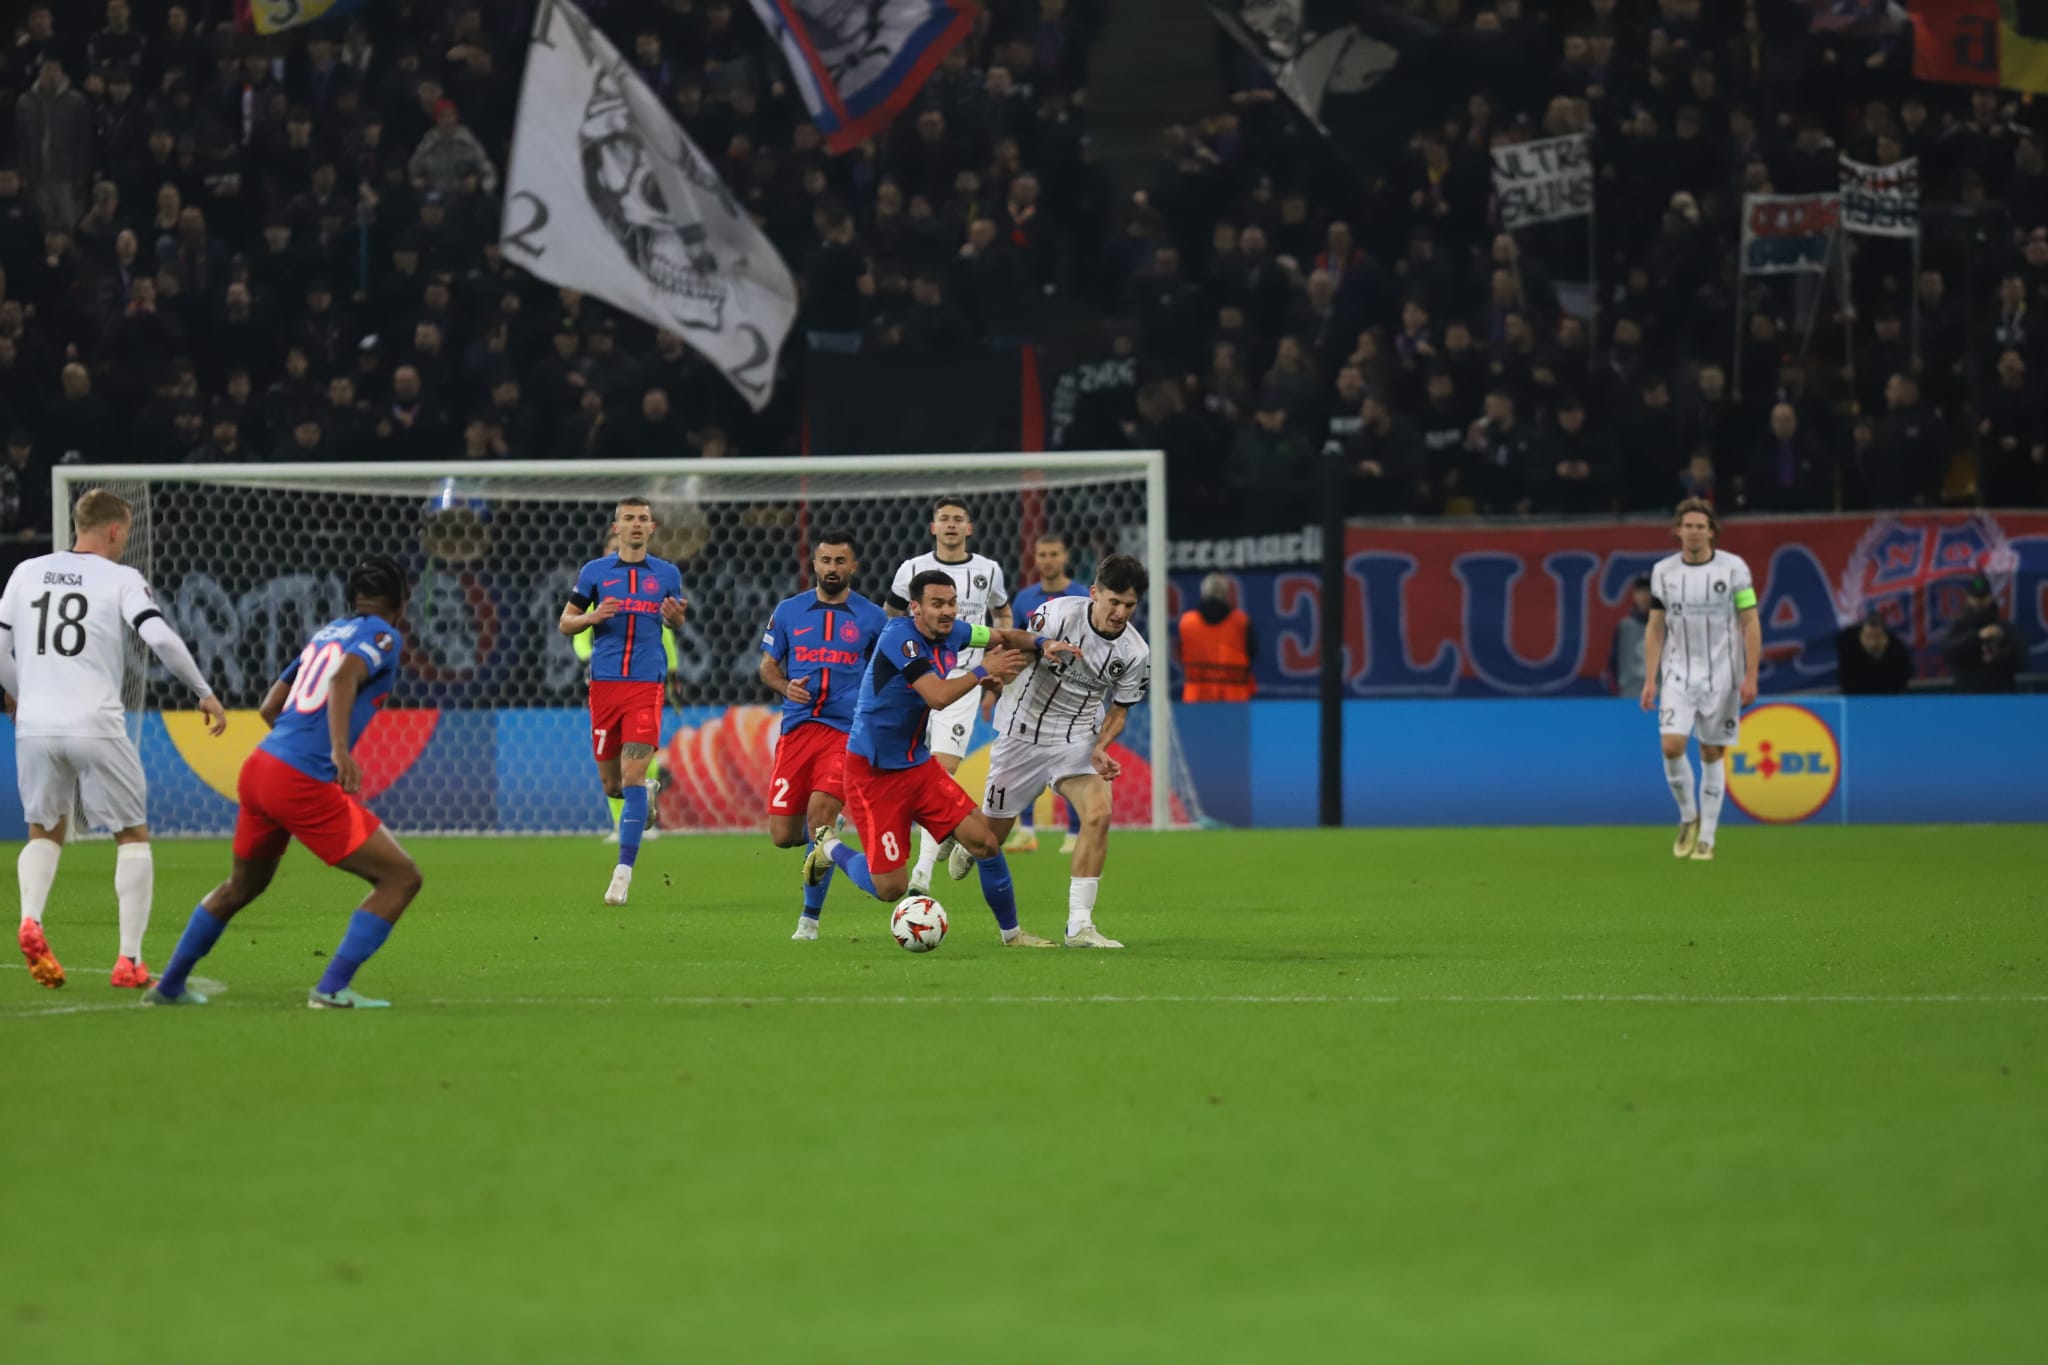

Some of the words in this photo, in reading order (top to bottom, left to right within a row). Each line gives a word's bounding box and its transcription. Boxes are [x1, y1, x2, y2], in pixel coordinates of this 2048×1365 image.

[43, 571, 83, 587] BUKSA
[30, 590, 88, 657] 18
[793, 645, 860, 665] Betano
[593, 728, 607, 755] 7
[772, 777, 790, 808] 2
[987, 784, 1006, 811] 41
[881, 831, 900, 862] 8
